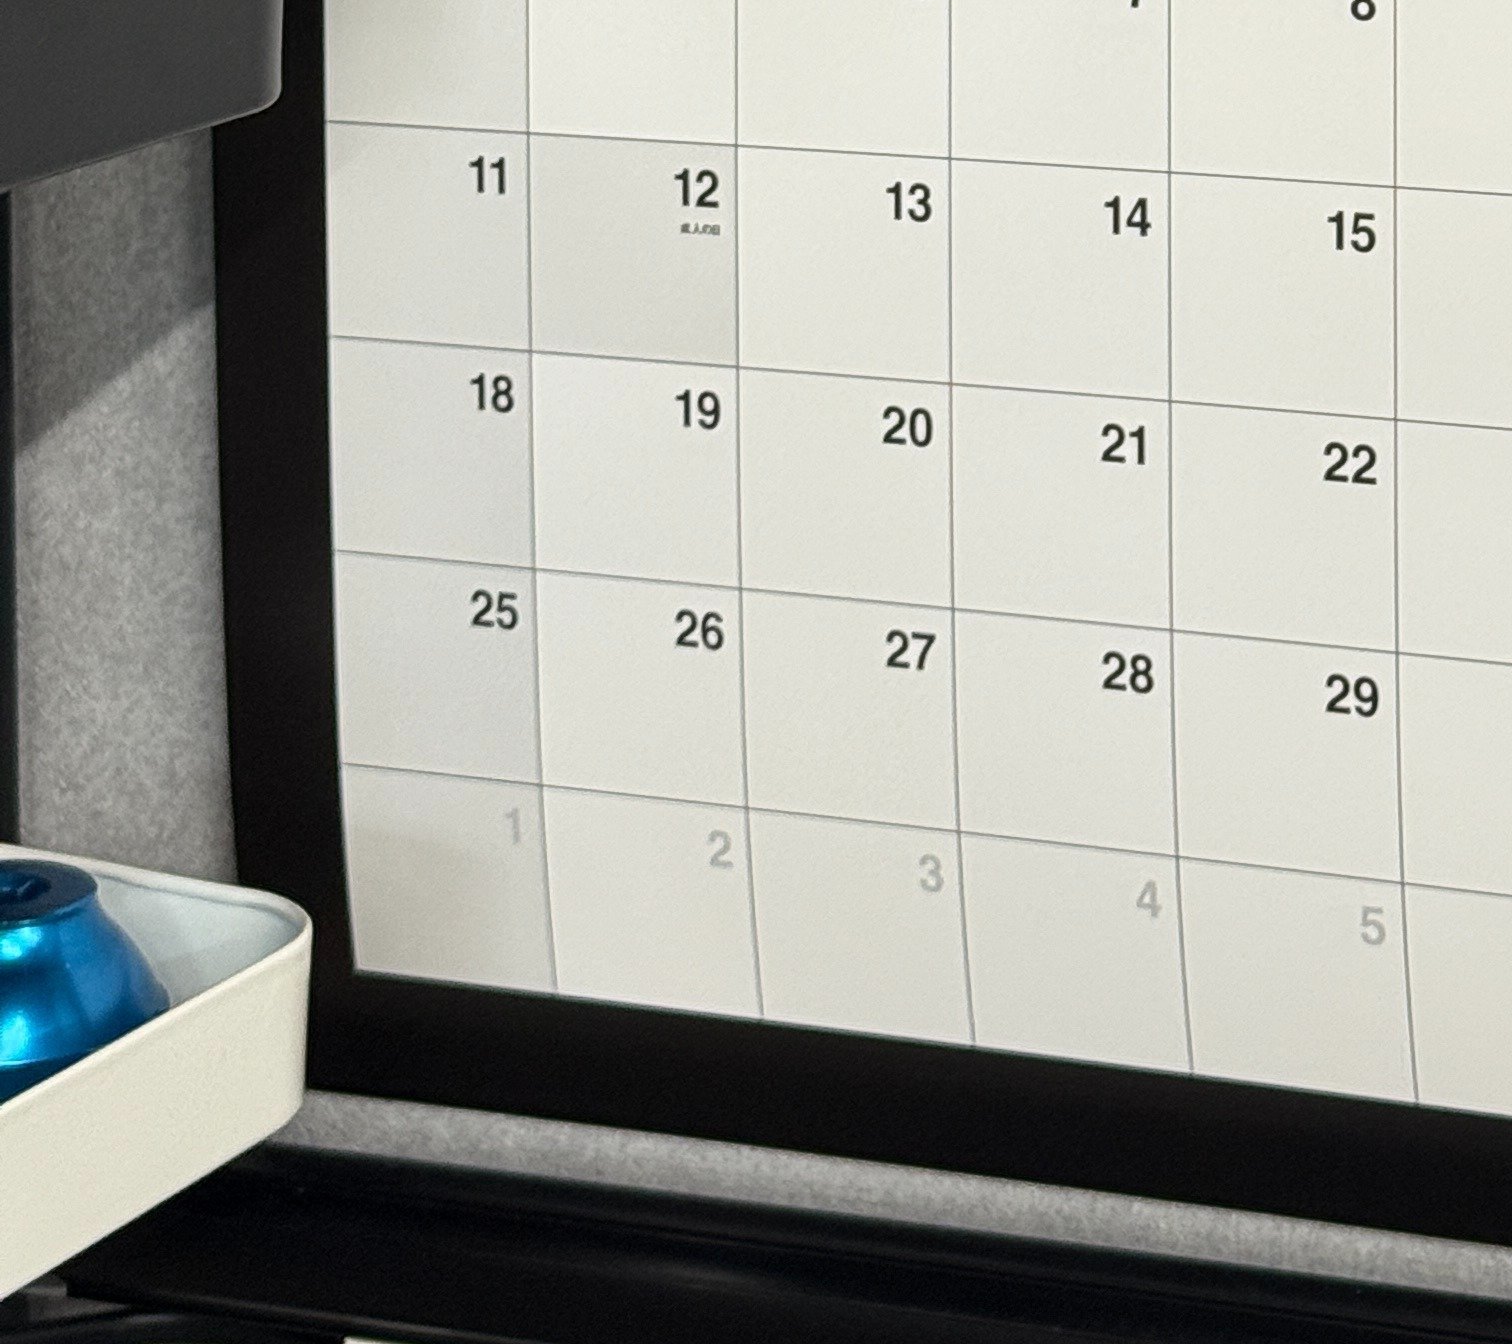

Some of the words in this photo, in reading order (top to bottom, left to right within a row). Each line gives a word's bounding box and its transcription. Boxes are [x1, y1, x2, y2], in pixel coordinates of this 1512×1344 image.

[467, 154, 508, 196] 11
[673, 167, 721, 210] 12
[885, 180, 933, 224] 13
[1103, 194, 1153, 238] 14
[1326, 209, 1377, 254] 15
[468, 371, 516, 415] 18
[673, 388, 722, 432] 19
[881, 404, 934, 449] 20
[1099, 422, 1149, 466] 21
[1322, 440, 1378, 486] 22
[469, 589, 519, 631] 25
[673, 607, 726, 653] 26
[883, 628, 937, 673] 27
[1100, 649, 1156, 696] 28
[1324, 672, 1380, 719] 29
[504, 806, 522, 846] 1
[707, 829, 734, 870] 2
[918, 853, 945, 893] 3
[1135, 879, 1163, 919] 4
[1360, 905, 1387, 946] 5
